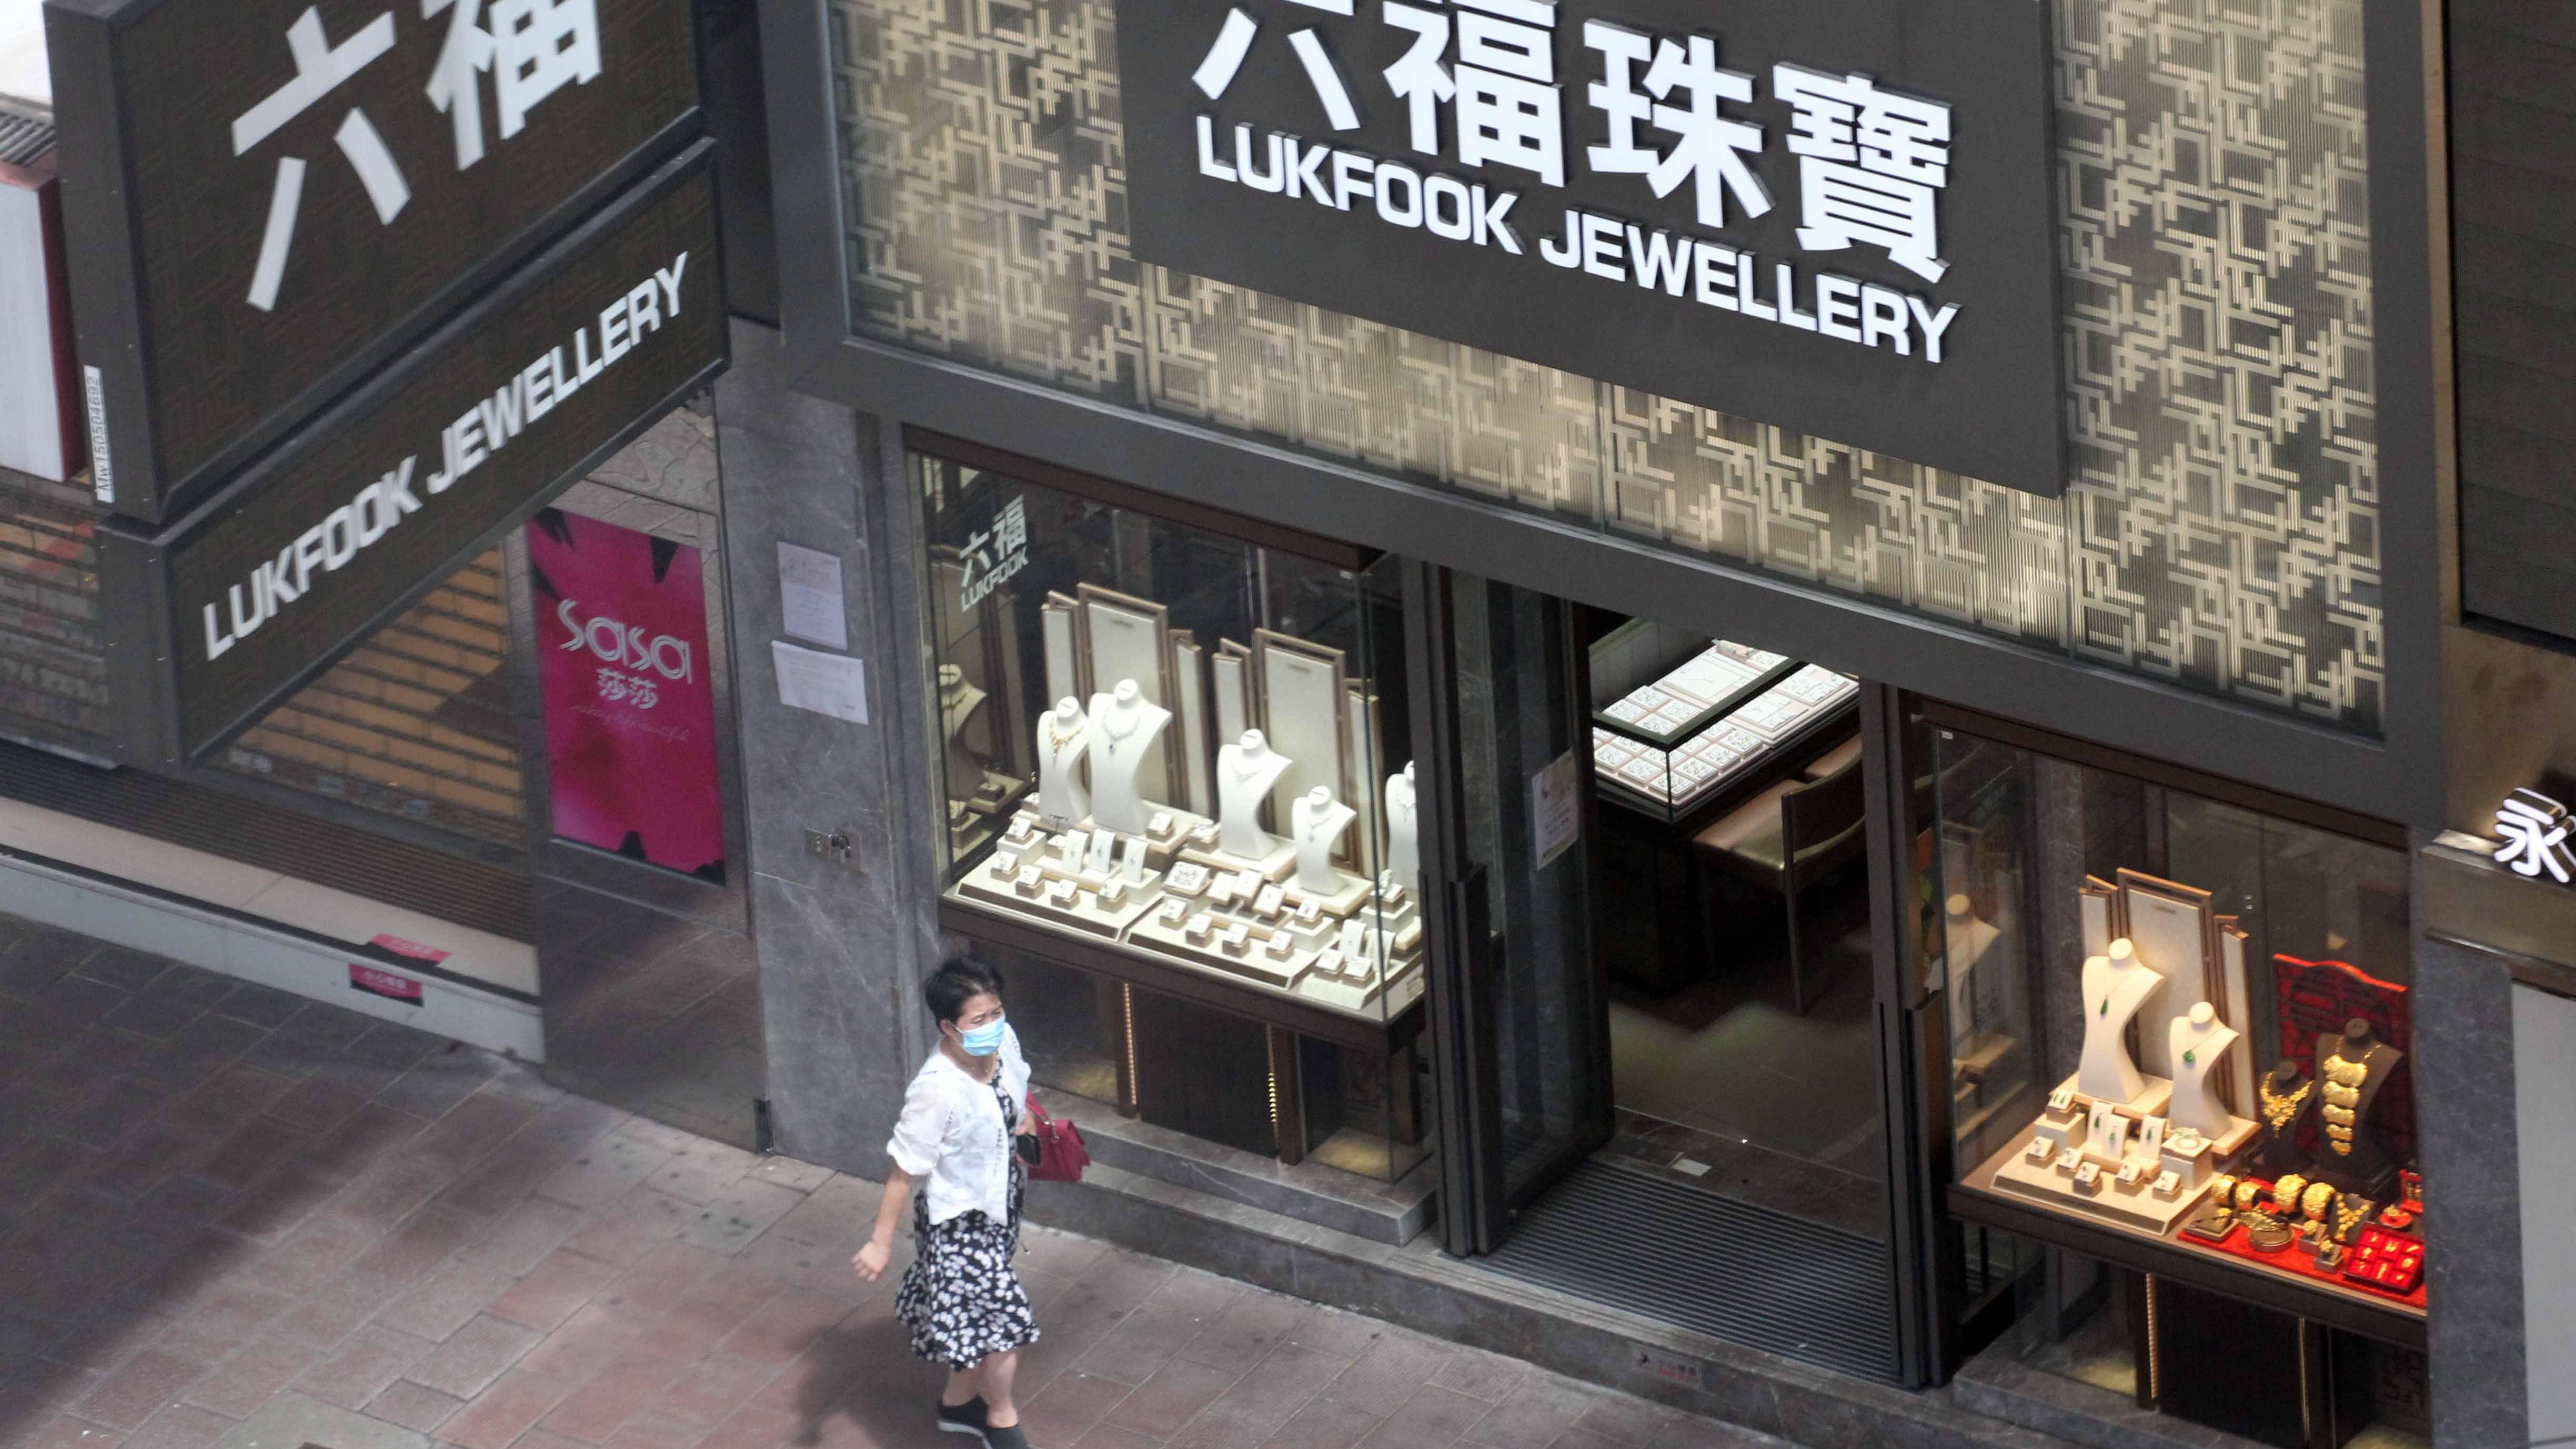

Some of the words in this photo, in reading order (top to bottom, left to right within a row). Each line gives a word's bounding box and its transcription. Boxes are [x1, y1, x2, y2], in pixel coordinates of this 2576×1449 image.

[1196, 114, 1523, 255] LUKFOOK
[1539, 209, 1959, 364] JEWELLERY
[204, 456, 422, 661] LUKFOOK
[427, 250, 689, 495] JEWELLERY
[959, 494, 1027, 588] 六福
[961, 545, 1029, 612] LUKFOOK
[597, 667, 658, 709] 莎莎
[2494, 794, 2573, 883] 永
